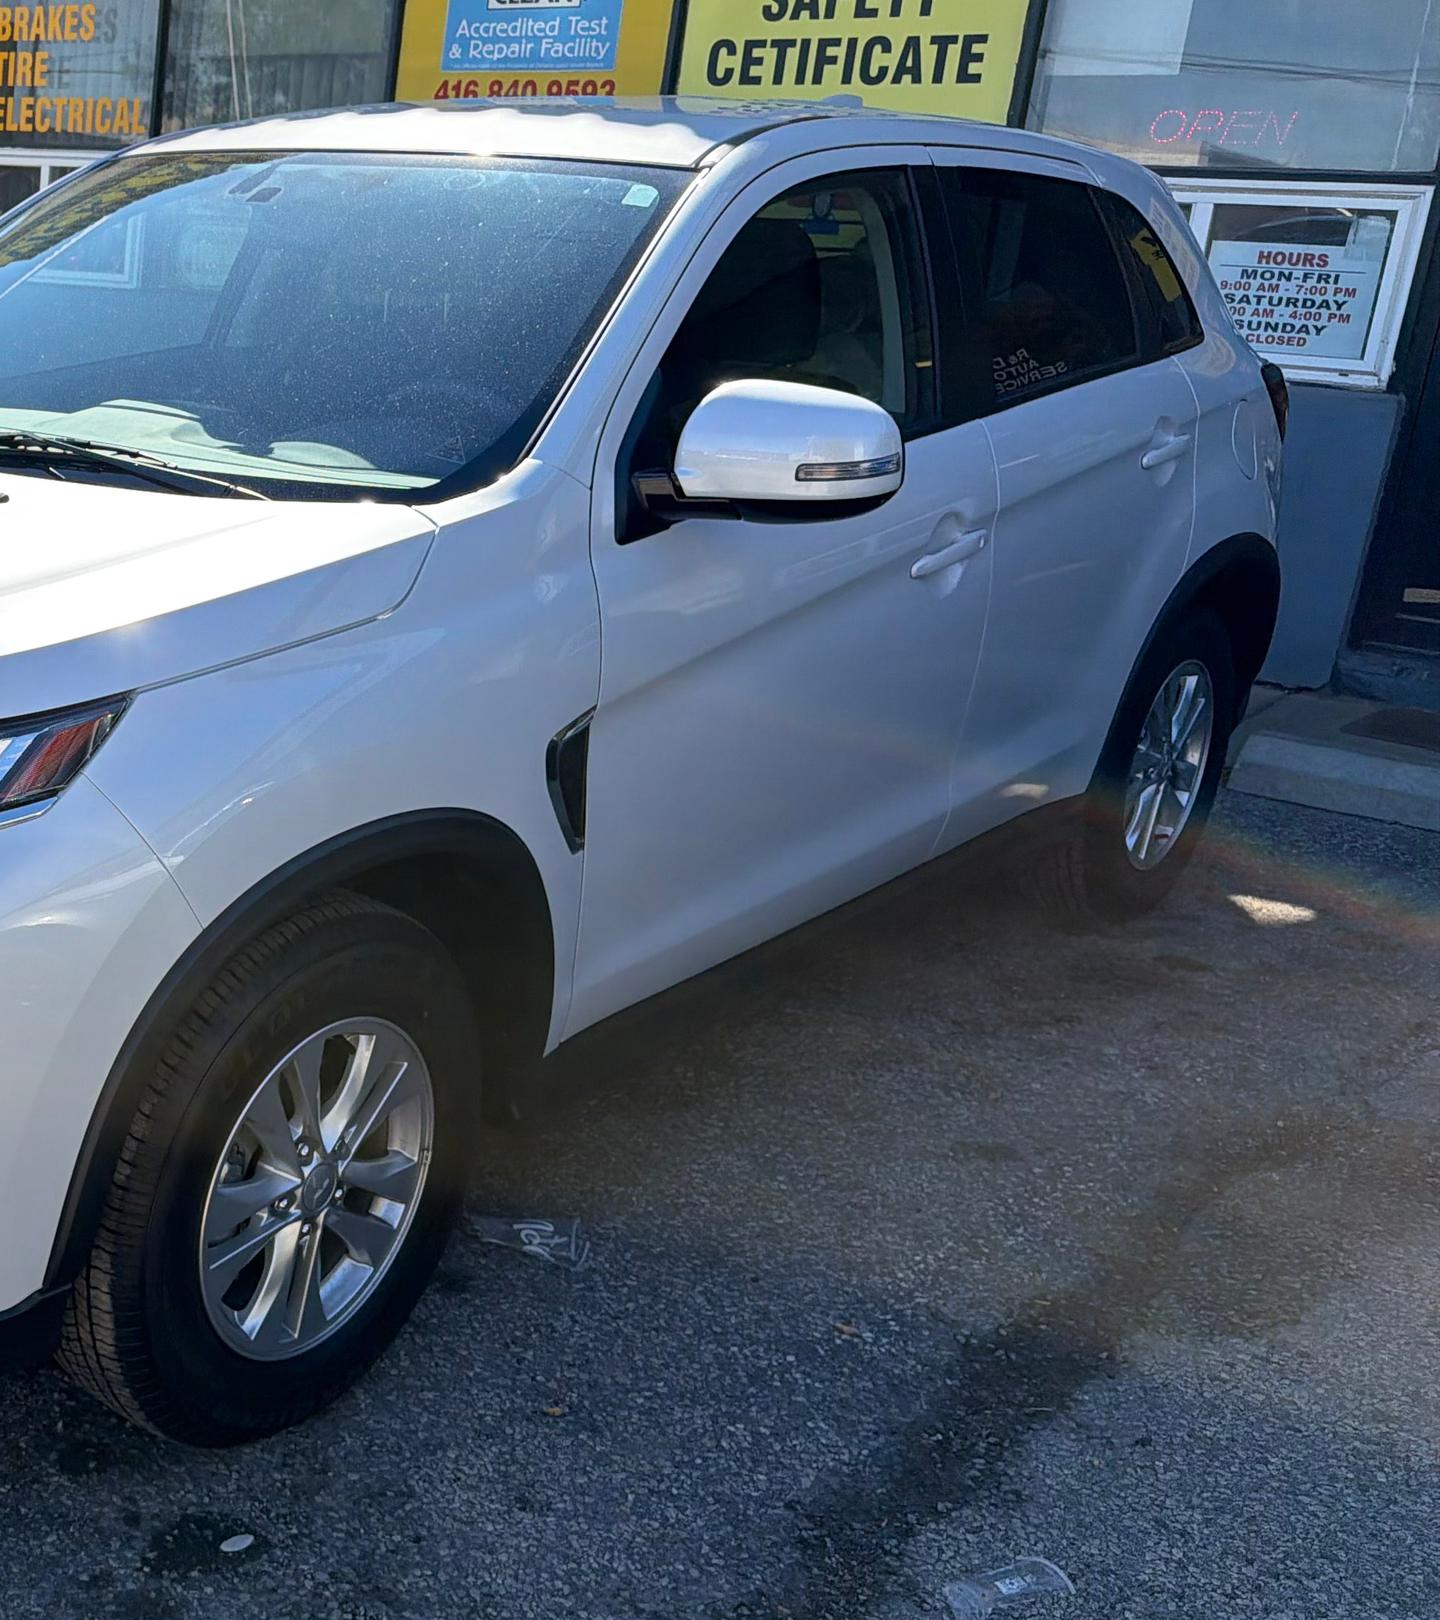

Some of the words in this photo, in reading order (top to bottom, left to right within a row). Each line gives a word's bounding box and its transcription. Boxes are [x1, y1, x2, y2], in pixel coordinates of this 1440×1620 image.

[456, 16, 560, 38] Accredited
[568, 15, 609, 36] Test
[448, 43, 461, 59] &
[468, 39, 535, 61] Repair
[540, 38, 610, 60] Facility
[706, 33, 990, 87] CETIFICATE
[434, 79, 479, 100] 416
[487, 79, 538, 98] 840
[1150, 109, 1299, 145] OPEN
[1257, 250, 1330, 268] HOURS
[1240, 268, 1341, 285] MON-FRI
[1220, 280, 1252, 291] 9:00
[1256, 282, 1281, 294] AM
[1295, 284, 1328, 296] 7:00
[1332, 286, 1357, 298] PM
[1224, 292, 1349, 312] SATURDAY
[1229, 306, 1246, 317] 00
[1250, 307, 1274, 318] AM
[1288, 309, 1322, 322] 4:00
[1327, 313, 1351, 324] PM
[1234, 319, 1328, 337] SUNDAY
[1245, 333, 1307, 347] CLOSED
